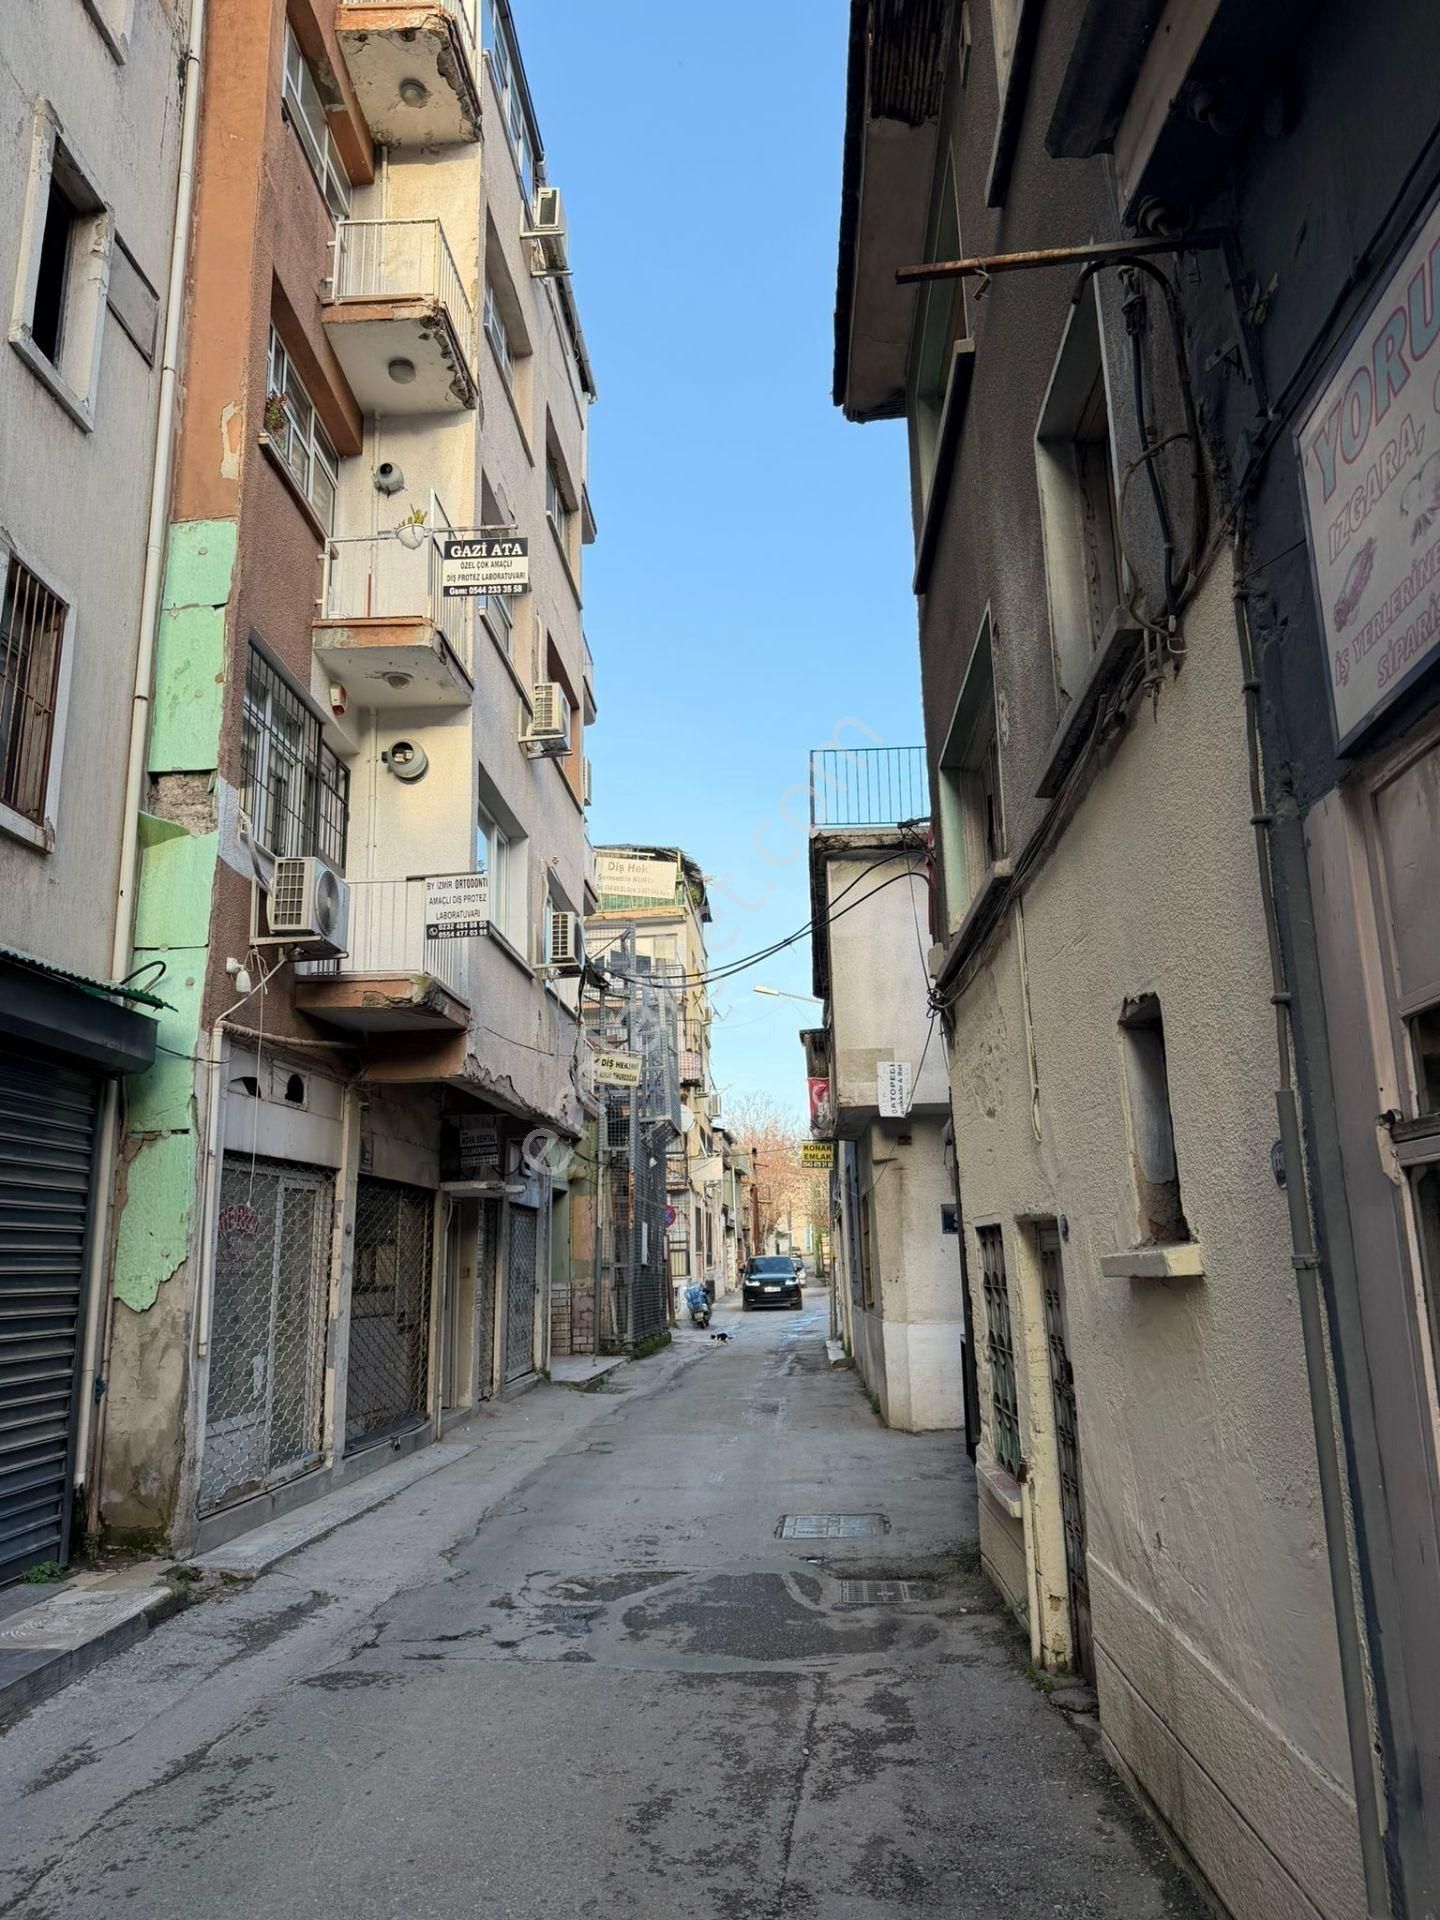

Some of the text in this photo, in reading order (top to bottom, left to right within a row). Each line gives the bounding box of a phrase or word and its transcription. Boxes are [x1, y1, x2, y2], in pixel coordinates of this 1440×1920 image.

[450, 542, 523, 558] GAZİ ATA
[460, 560, 513, 571] ÖZEL ÇOK AMAÇLI
[446, 571, 526, 584] DİŞ PROTEZ LABORATUVARI
[468, 586, 487, 594] 0544
[488, 585, 501, 594] 233
[426, 881, 435, 890] BY
[463, 893, 487, 903] PROTEZ
[601, 1057, 614, 1070] DİŞ
